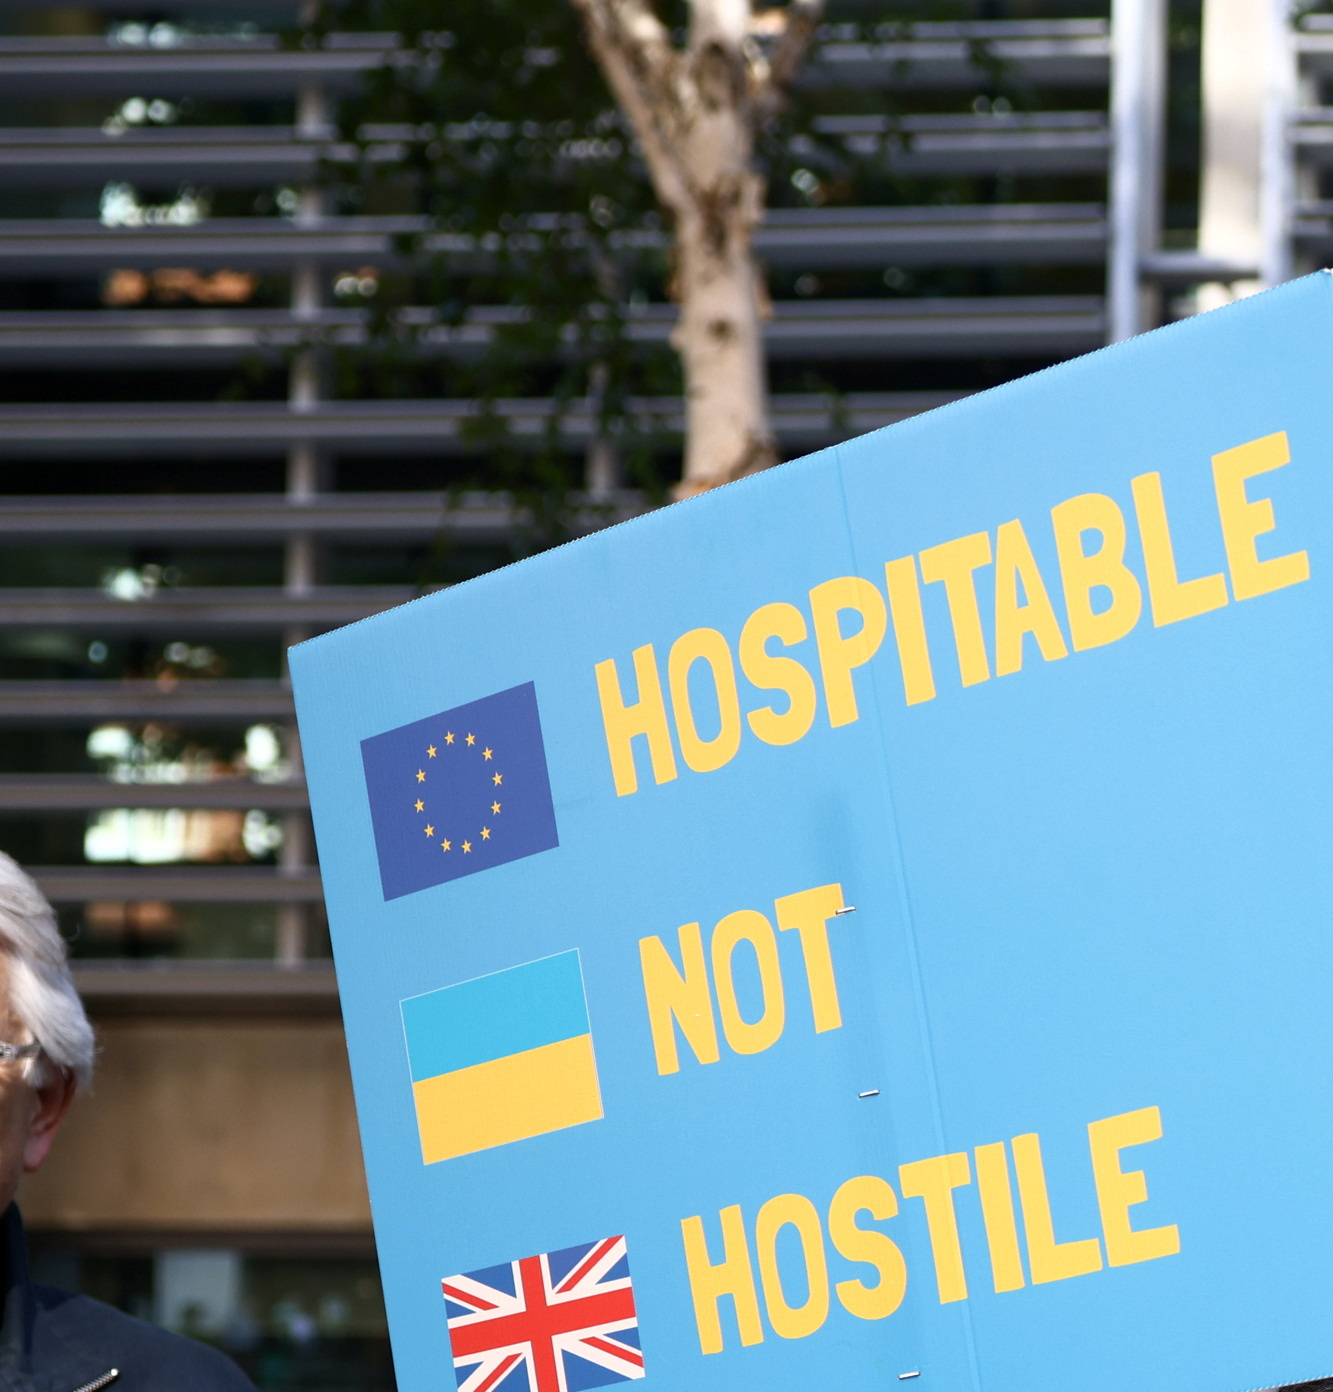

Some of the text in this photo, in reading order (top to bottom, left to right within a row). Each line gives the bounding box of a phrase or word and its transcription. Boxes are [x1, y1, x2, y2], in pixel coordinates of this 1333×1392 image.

[596, 432, 1310, 796] HOSPITABLE
[640, 884, 845, 1075] NOT
[682, 1107, 1180, 1355] HOSTILE
